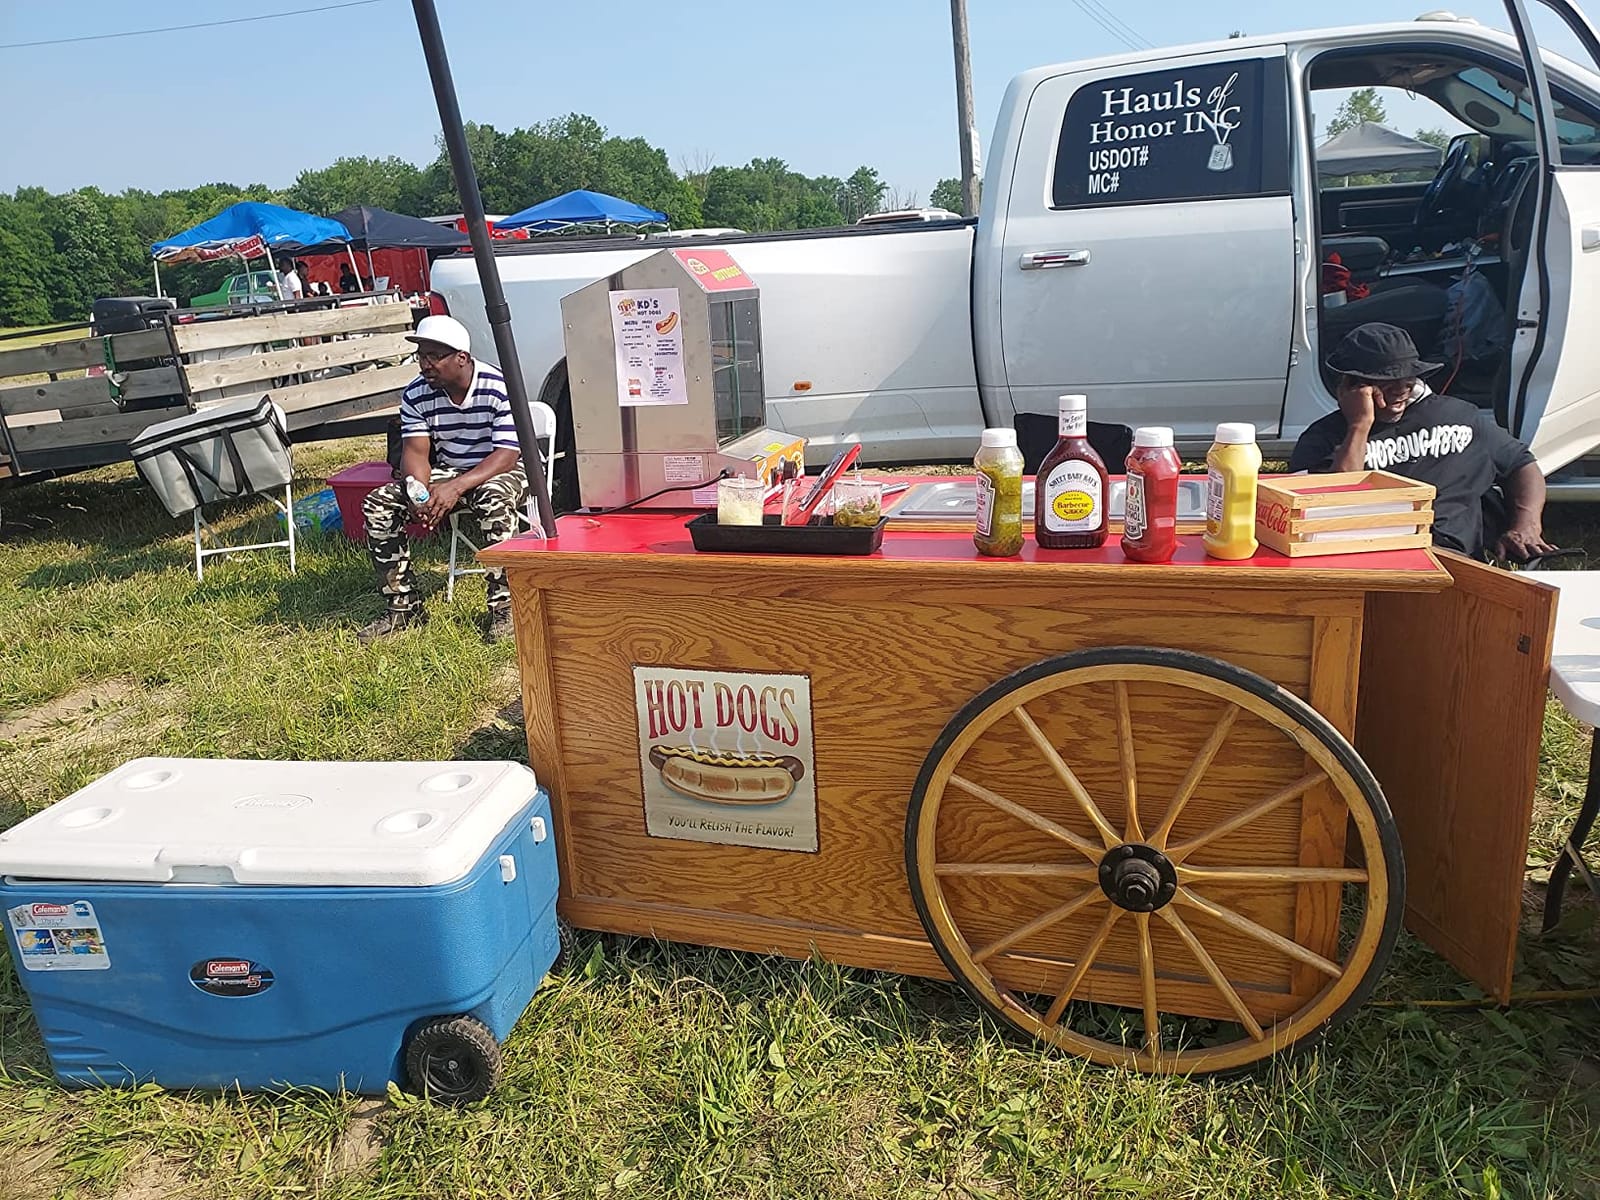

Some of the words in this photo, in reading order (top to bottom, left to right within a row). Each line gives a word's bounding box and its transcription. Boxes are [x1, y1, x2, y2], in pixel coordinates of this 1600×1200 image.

[1101, 79, 1201, 118] Hauls
[1207, 72, 1239, 111] of
[1089, 120, 1177, 144] Honor
[1183, 106, 1241, 135] INC
[1089, 145, 1149, 172] USDOT#
[1088, 171, 1120, 195] MC#
[637, 299, 659, 309] KD'S
[1049, 474, 1067, 488] SWEET
[643, 679, 705, 739] HOT
[713, 682, 800, 747] DOGS
[668, 816, 697, 829] YOU'LL
[699, 818, 732, 833] RELISH
[735, 822, 753, 834] THE
[755, 823, 795, 838] FLAVOR!
[33, 905, 61, 914] Coleman
[209, 963, 241, 974] Coleman
